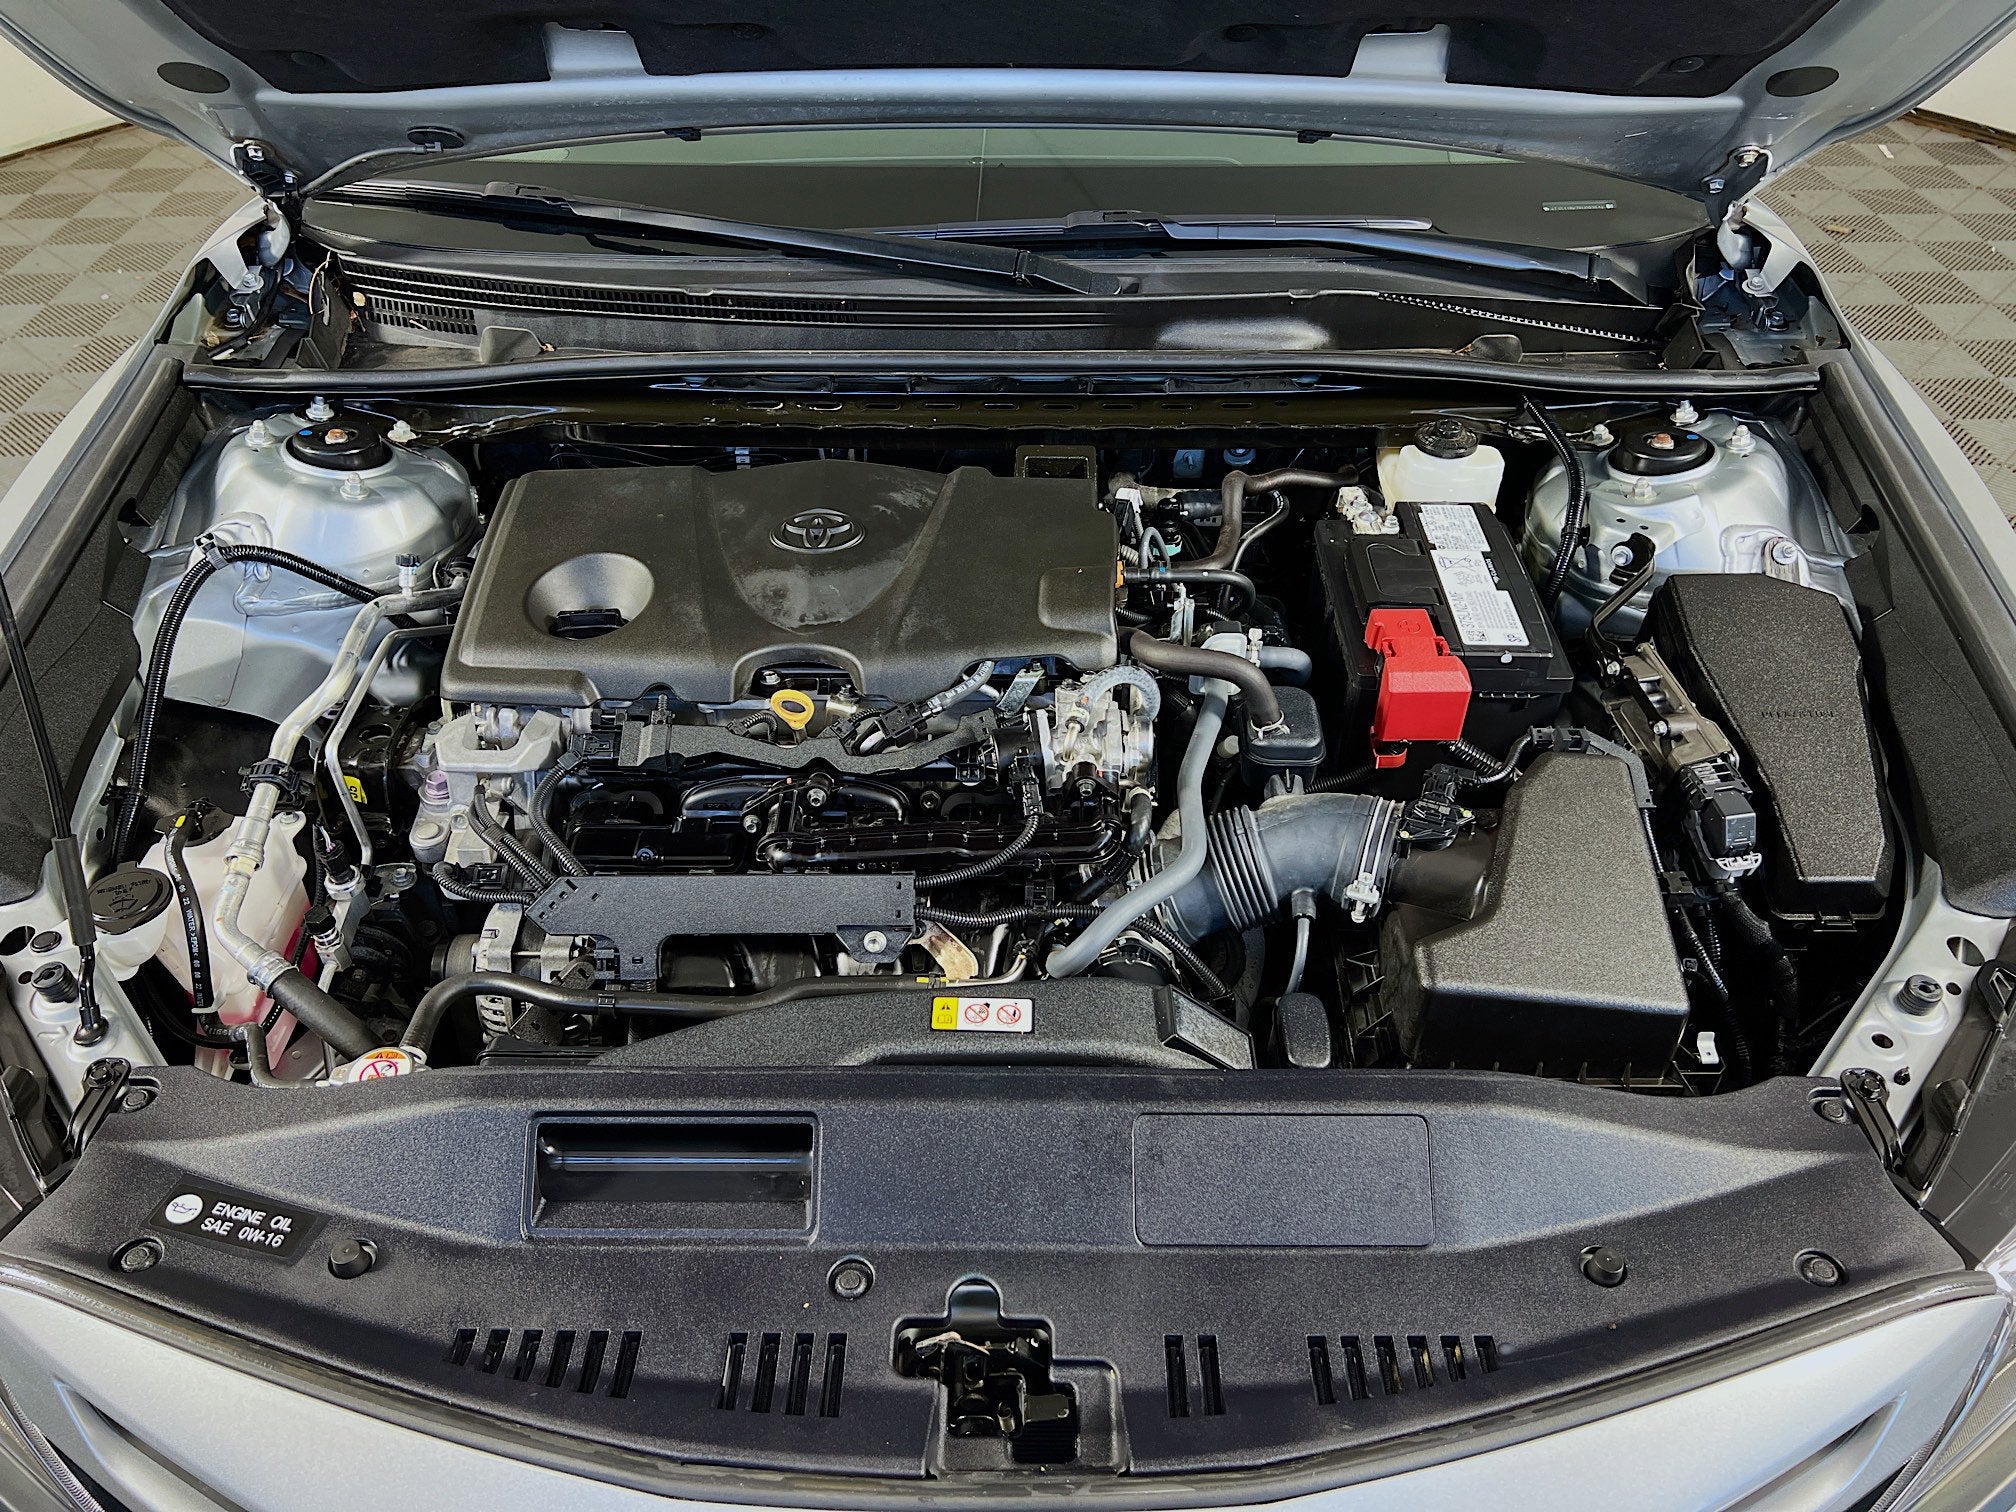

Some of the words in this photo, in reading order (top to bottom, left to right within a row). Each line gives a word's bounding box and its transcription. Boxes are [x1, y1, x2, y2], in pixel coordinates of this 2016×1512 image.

[186, 909, 196, 932] WATER
[200, 1217, 234, 1237] SAE
[238, 1226, 285, 1249] 0W-16
[211, 1201, 267, 1226] ENGINE
[270, 1215, 293, 1233] OIL
